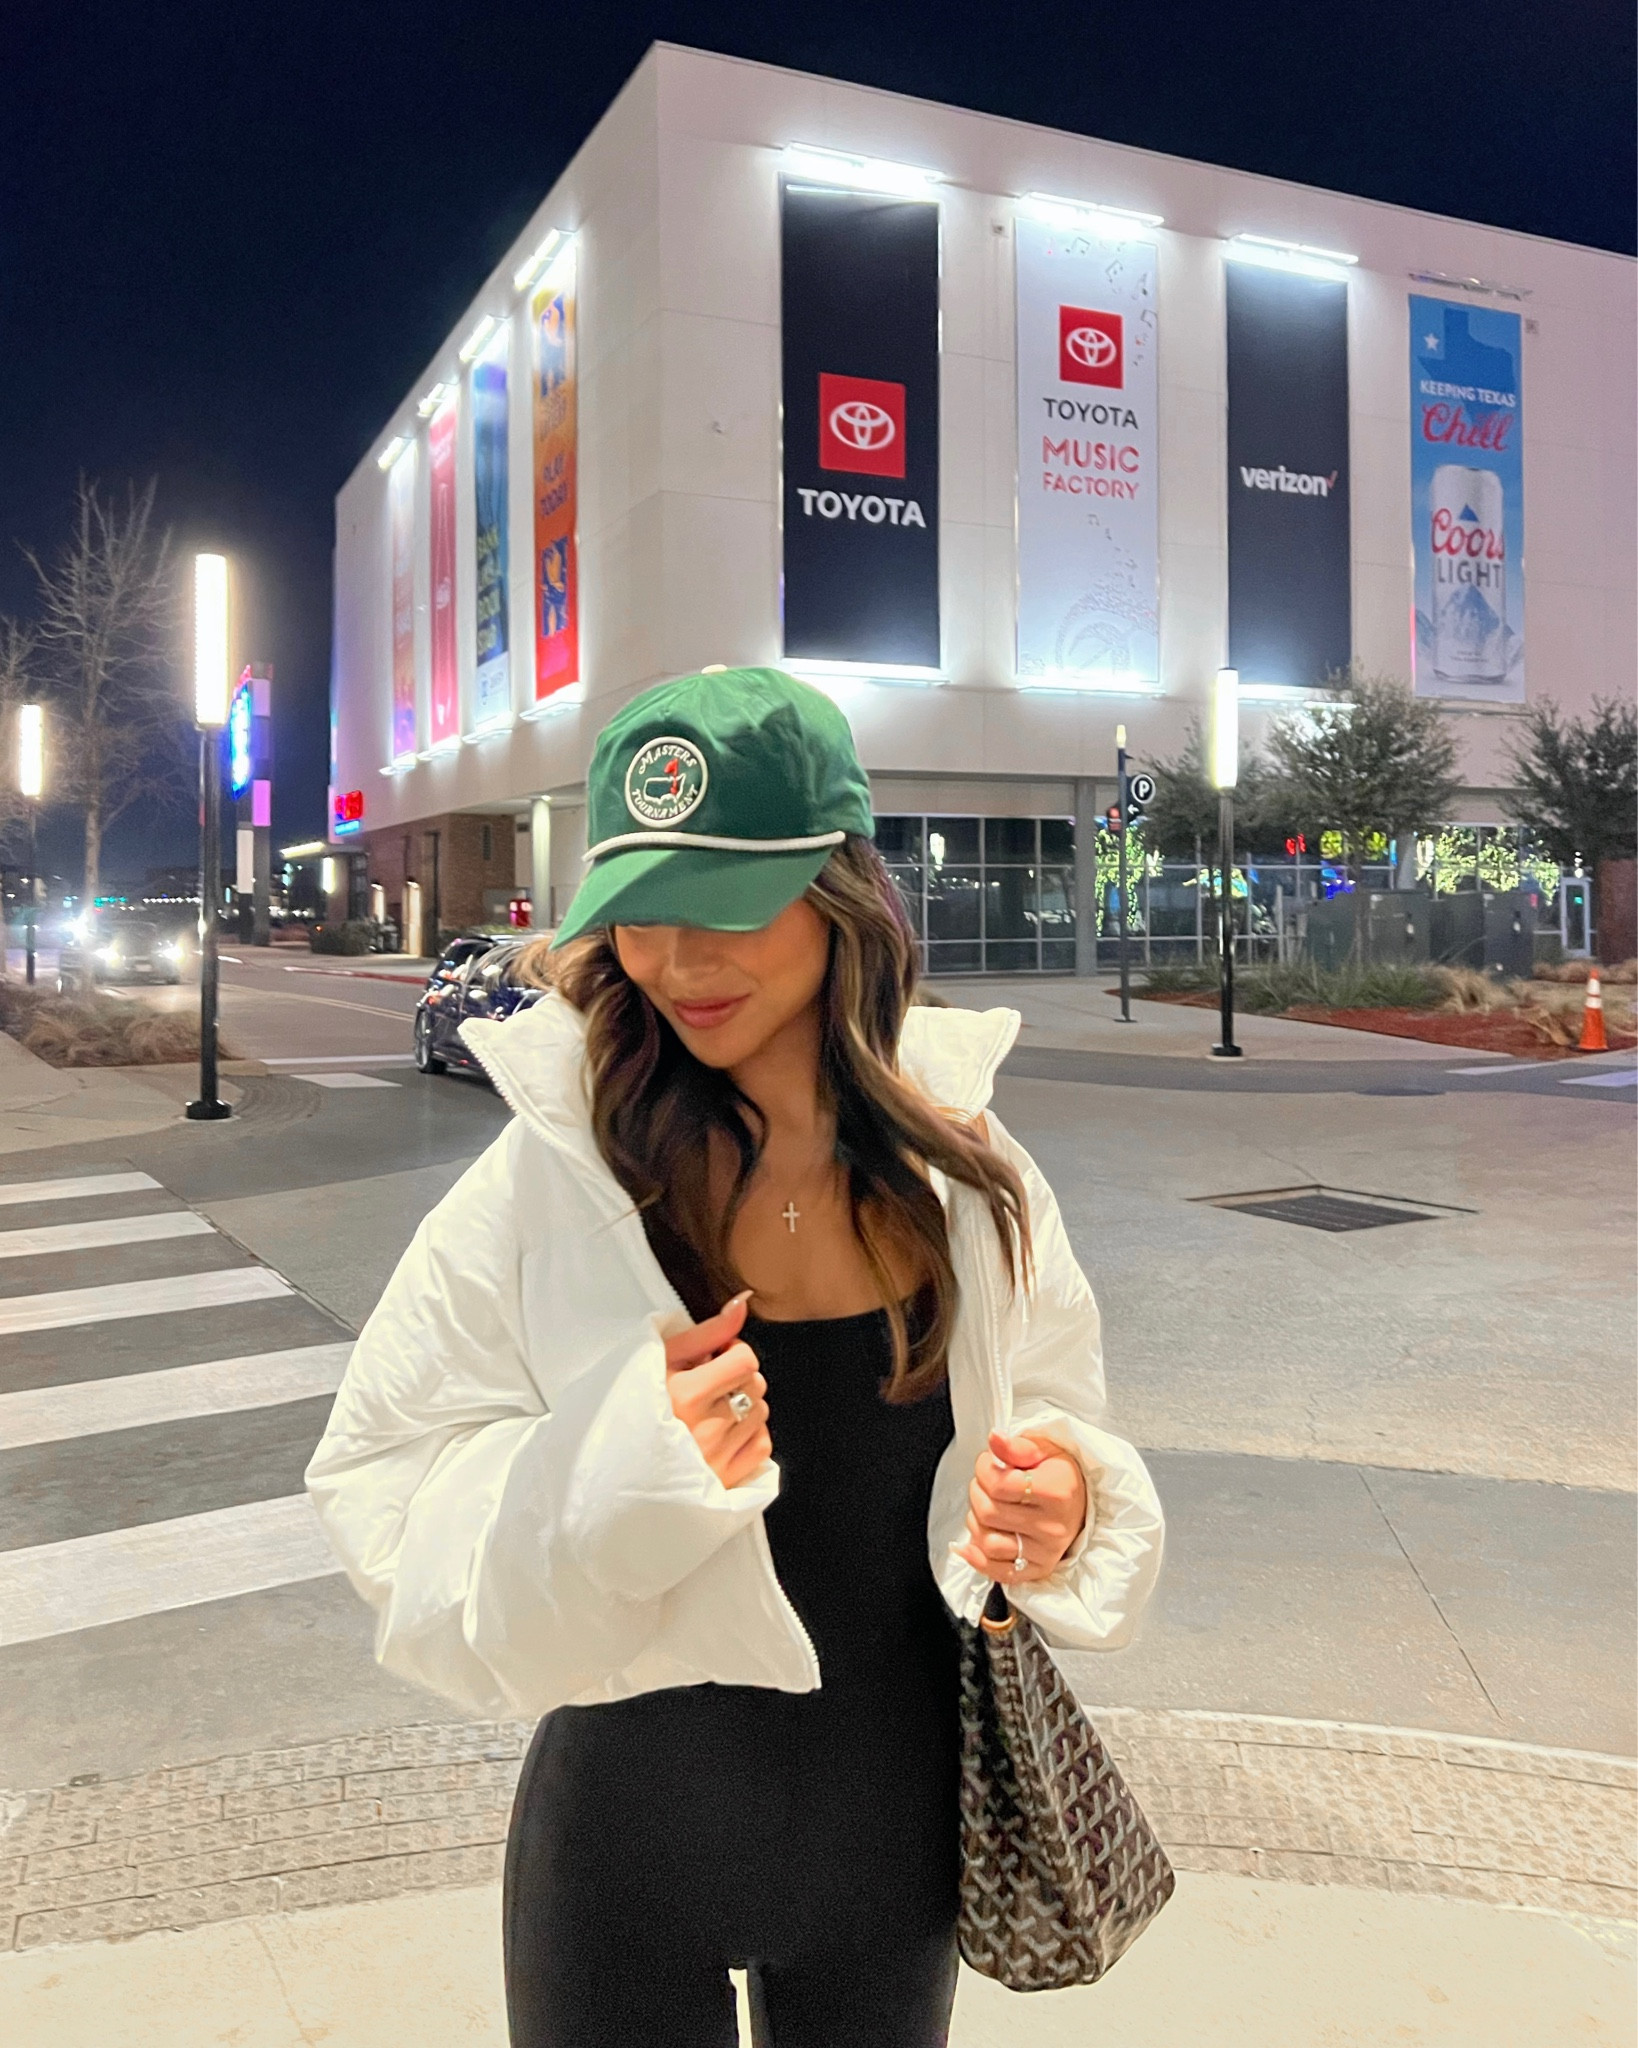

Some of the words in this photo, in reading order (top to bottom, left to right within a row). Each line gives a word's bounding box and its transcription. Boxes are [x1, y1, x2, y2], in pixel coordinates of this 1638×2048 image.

[1420, 379, 1477, 401] KEEPING
[1477, 387, 1516, 408] TEXAS
[1042, 397, 1139, 430] TOYOTA
[1421, 402, 1514, 452] Chill
[1042, 435, 1140, 474] MUSIC
[1042, 471, 1140, 500] FACTORY
[1240, 464, 1329, 497] verizon
[796, 487, 927, 529] TOYOTA
[1436, 557, 1502, 589] LIGHT
[631, 783, 699, 819] TOURNAMENT
[1138, 780, 1150, 798] P
